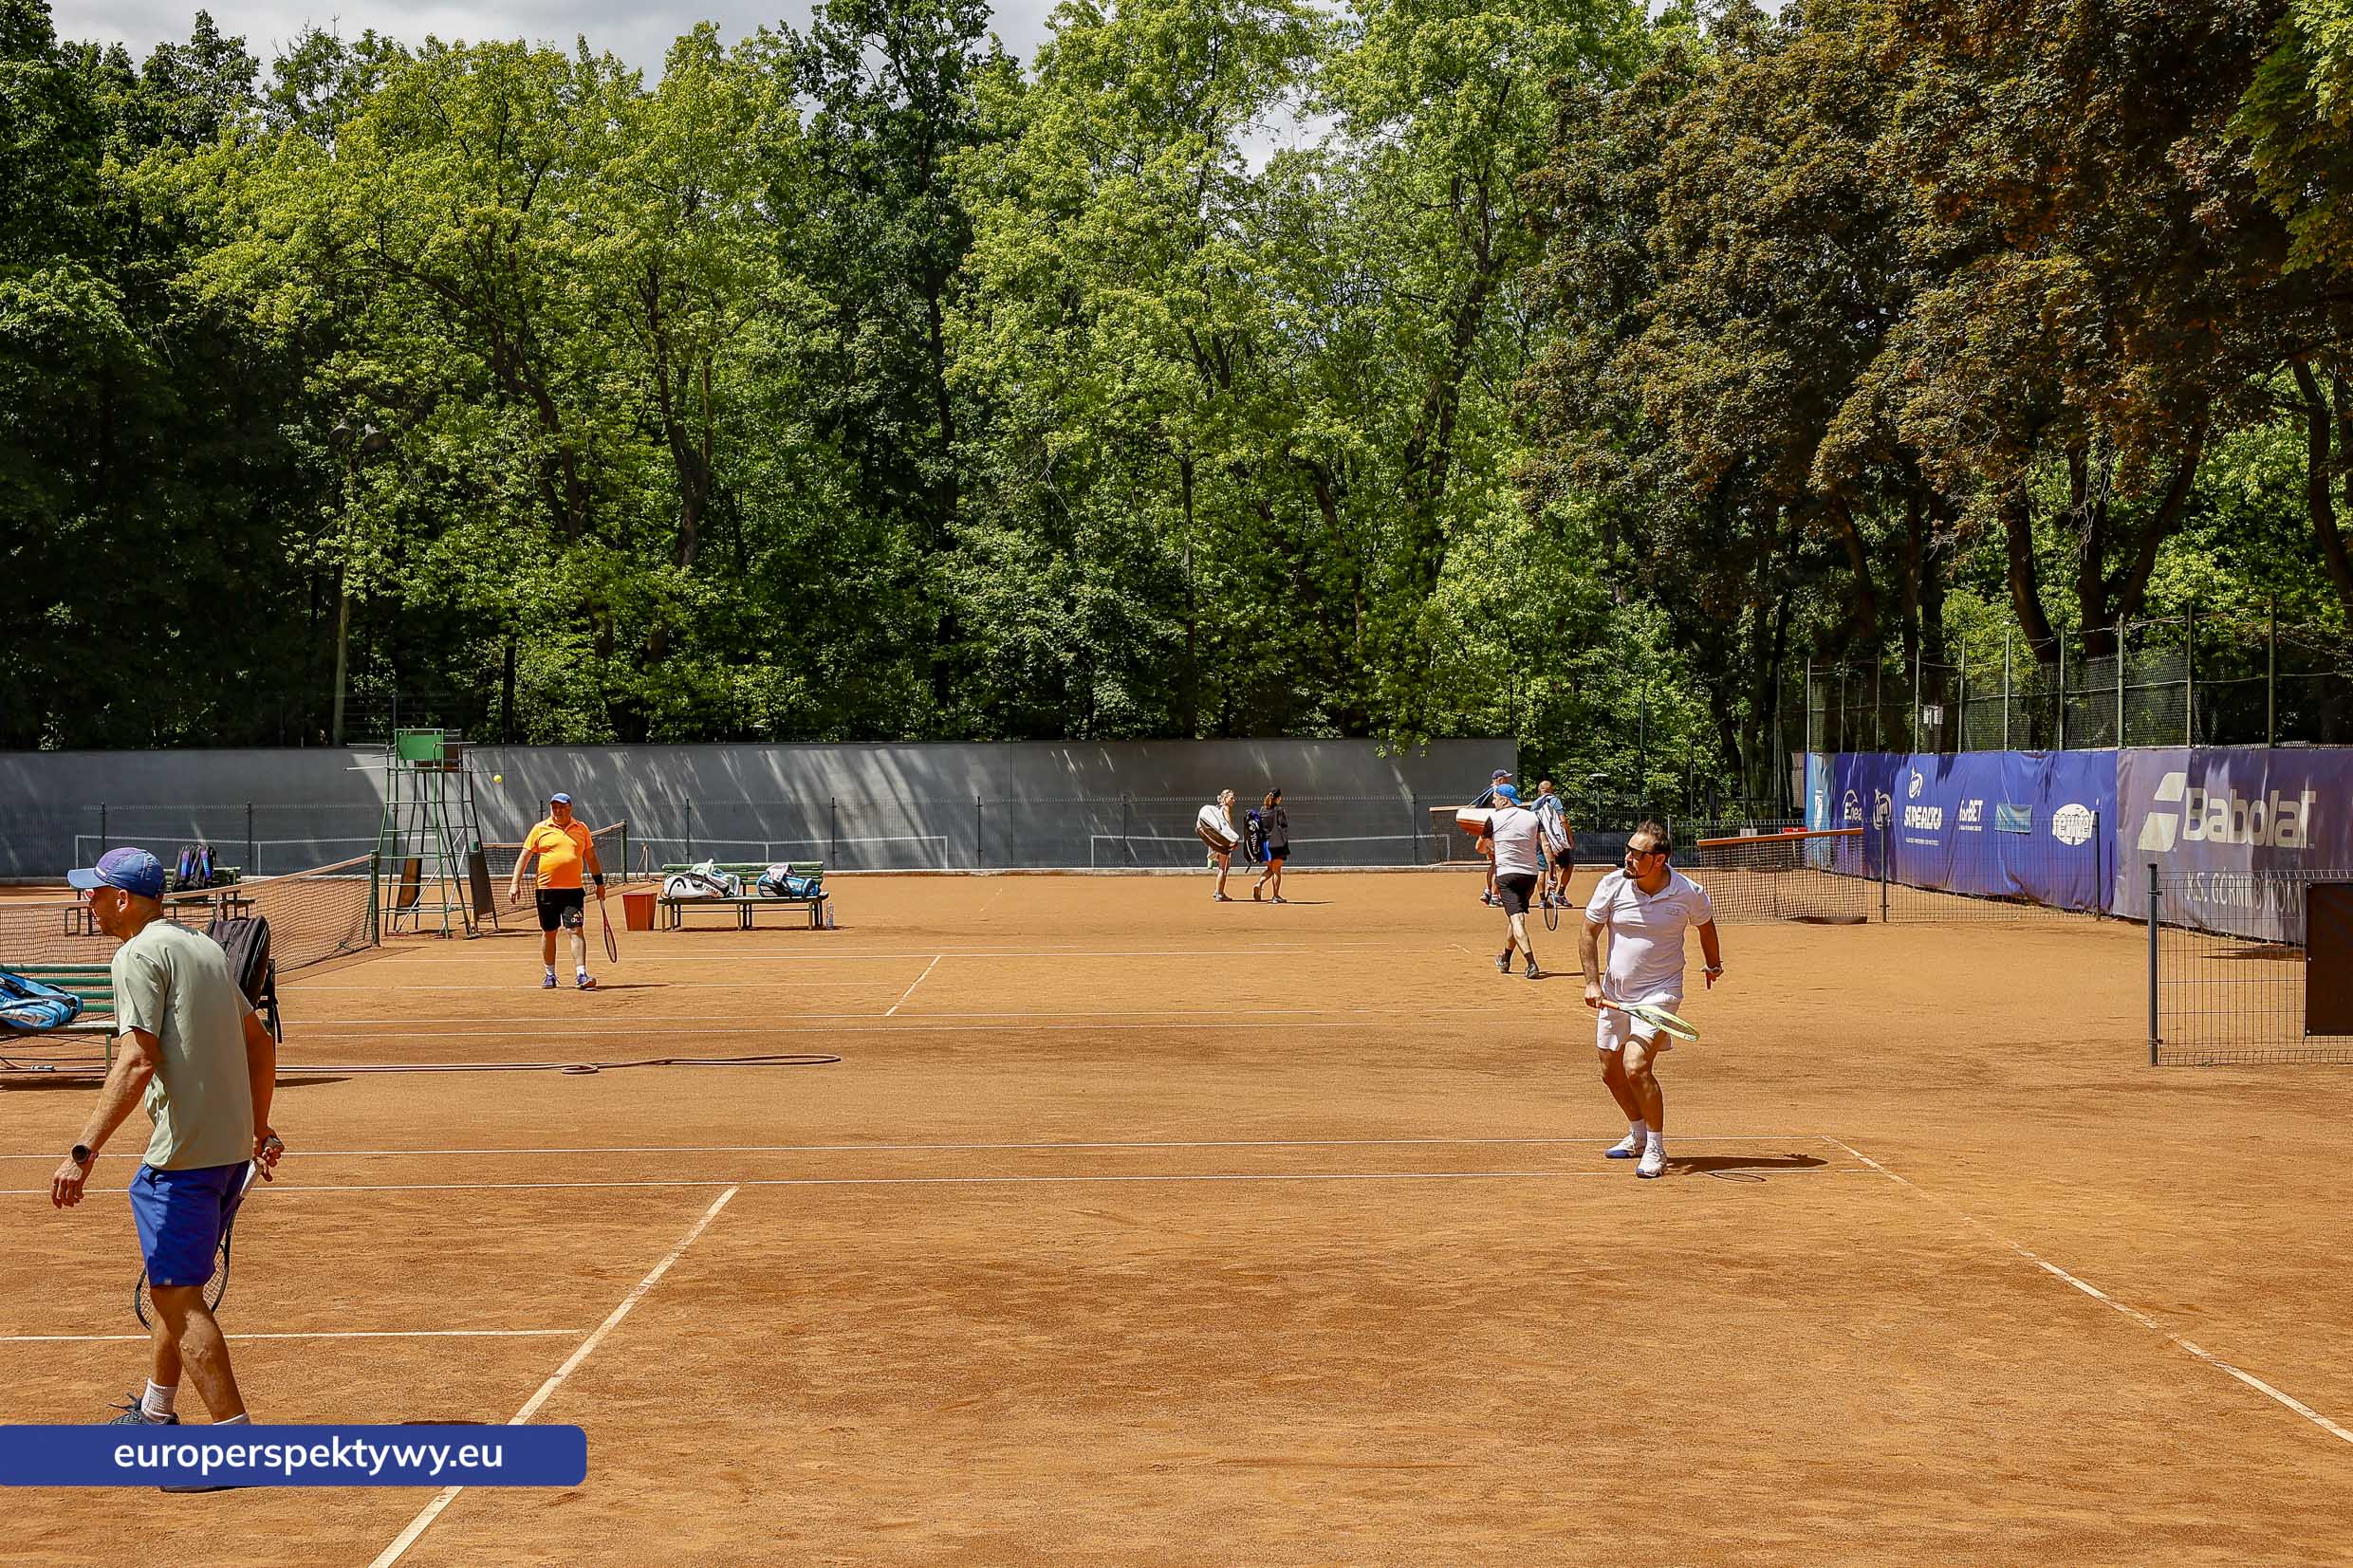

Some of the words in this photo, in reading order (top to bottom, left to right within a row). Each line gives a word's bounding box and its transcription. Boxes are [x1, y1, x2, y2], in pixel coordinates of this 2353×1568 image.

[1843, 802, 1862, 822] Enea
[1958, 799, 1984, 822] forBET
[2182, 787, 2316, 848] Babolat
